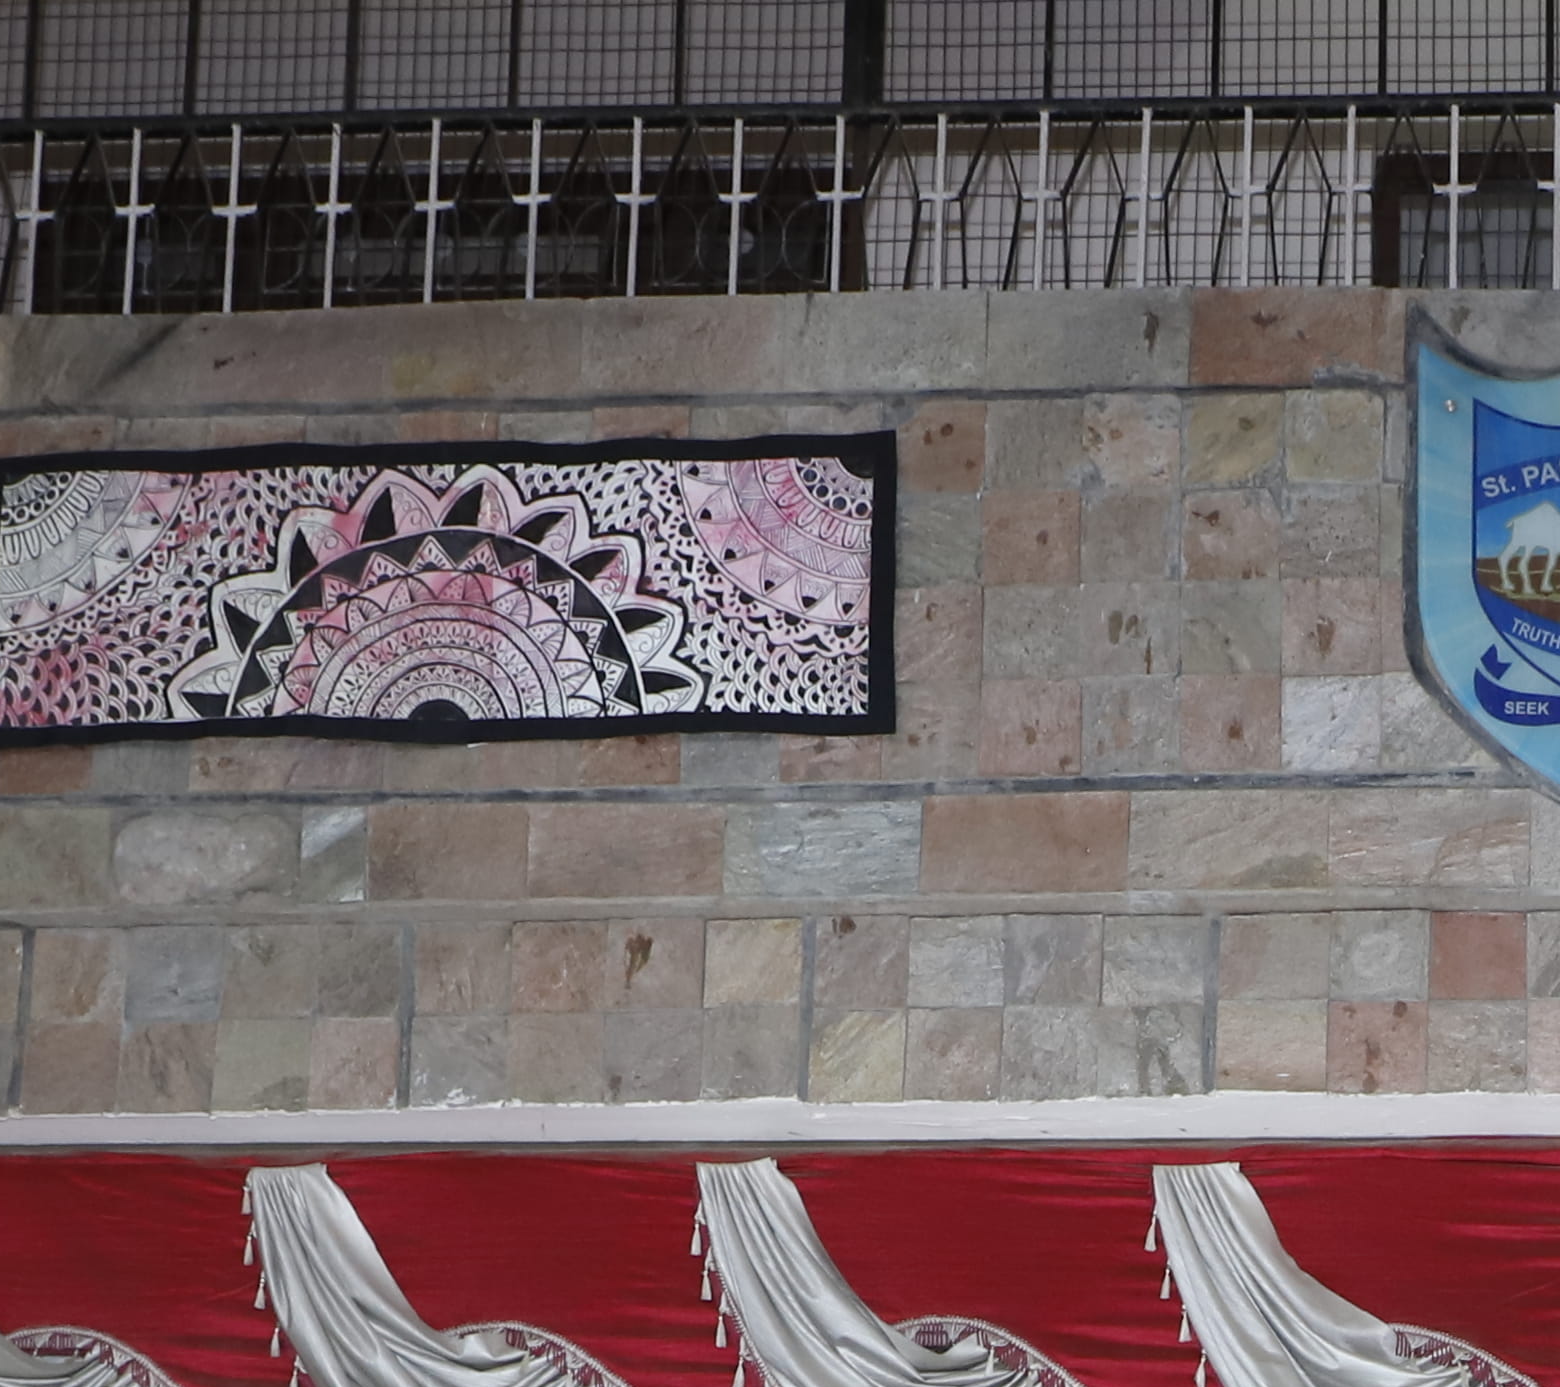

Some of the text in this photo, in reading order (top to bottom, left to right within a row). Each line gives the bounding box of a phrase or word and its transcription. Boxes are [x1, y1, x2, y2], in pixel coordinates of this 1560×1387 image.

[1481, 474, 1516, 498] St.
[1511, 616, 1560, 650] TRUTH
[1504, 700, 1550, 717] SEEK
